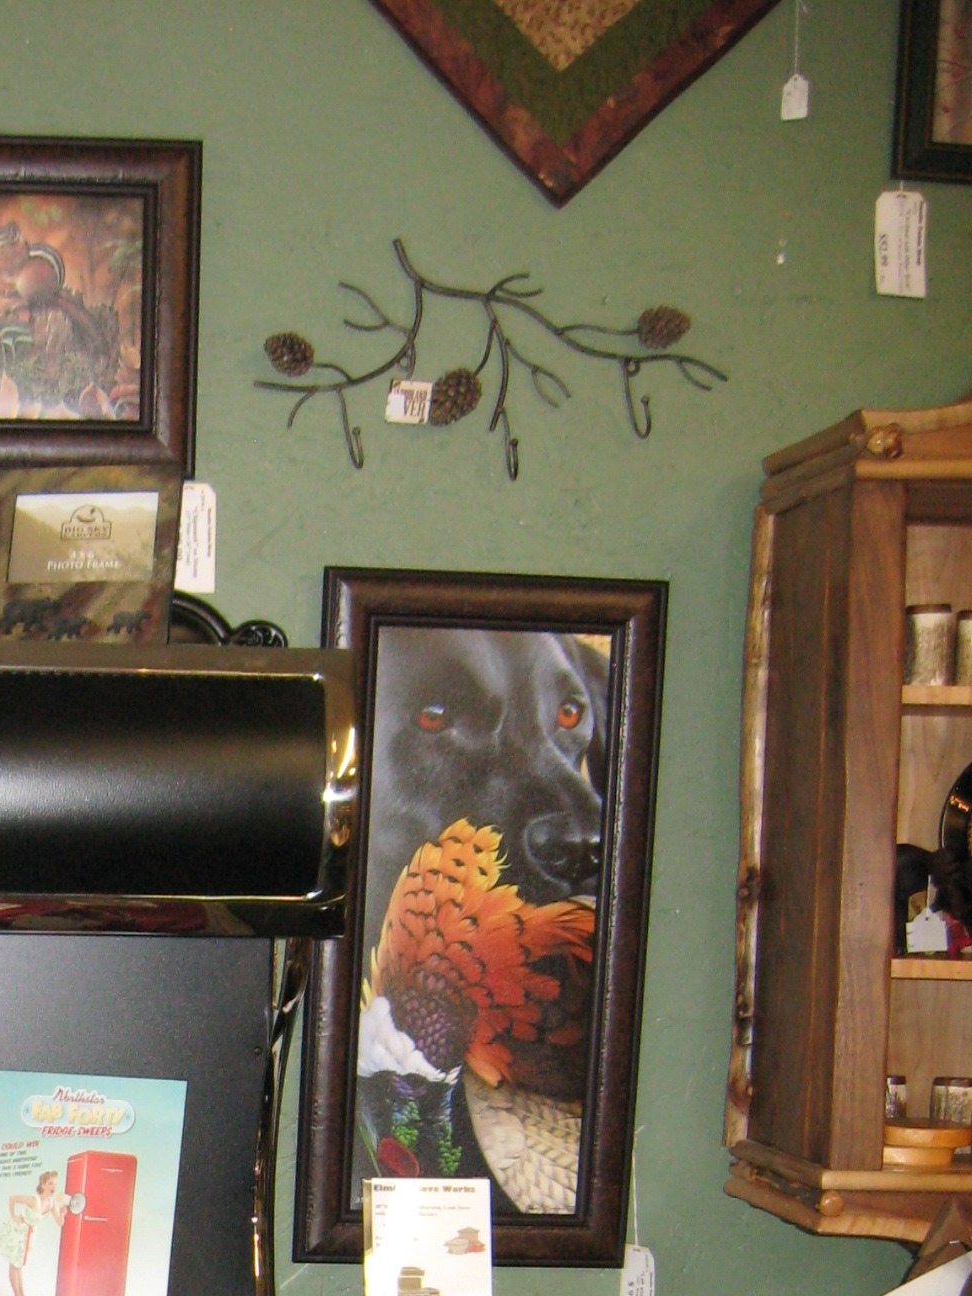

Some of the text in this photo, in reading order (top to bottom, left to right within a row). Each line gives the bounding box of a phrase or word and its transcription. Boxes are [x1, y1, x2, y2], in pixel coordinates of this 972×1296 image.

[47, 560, 121, 571] PHOTO FRAME
[53, 1087, 106, 1104] Northstar
[31, 1101, 127, 1127] FAB FORTY
[76, 1126, 113, 1138] SWEEPS
[1, 1141, 25, 1151] COULD
[26, 1139, 40, 1148] WIN
[442, 1185, 476, 1194] Works
